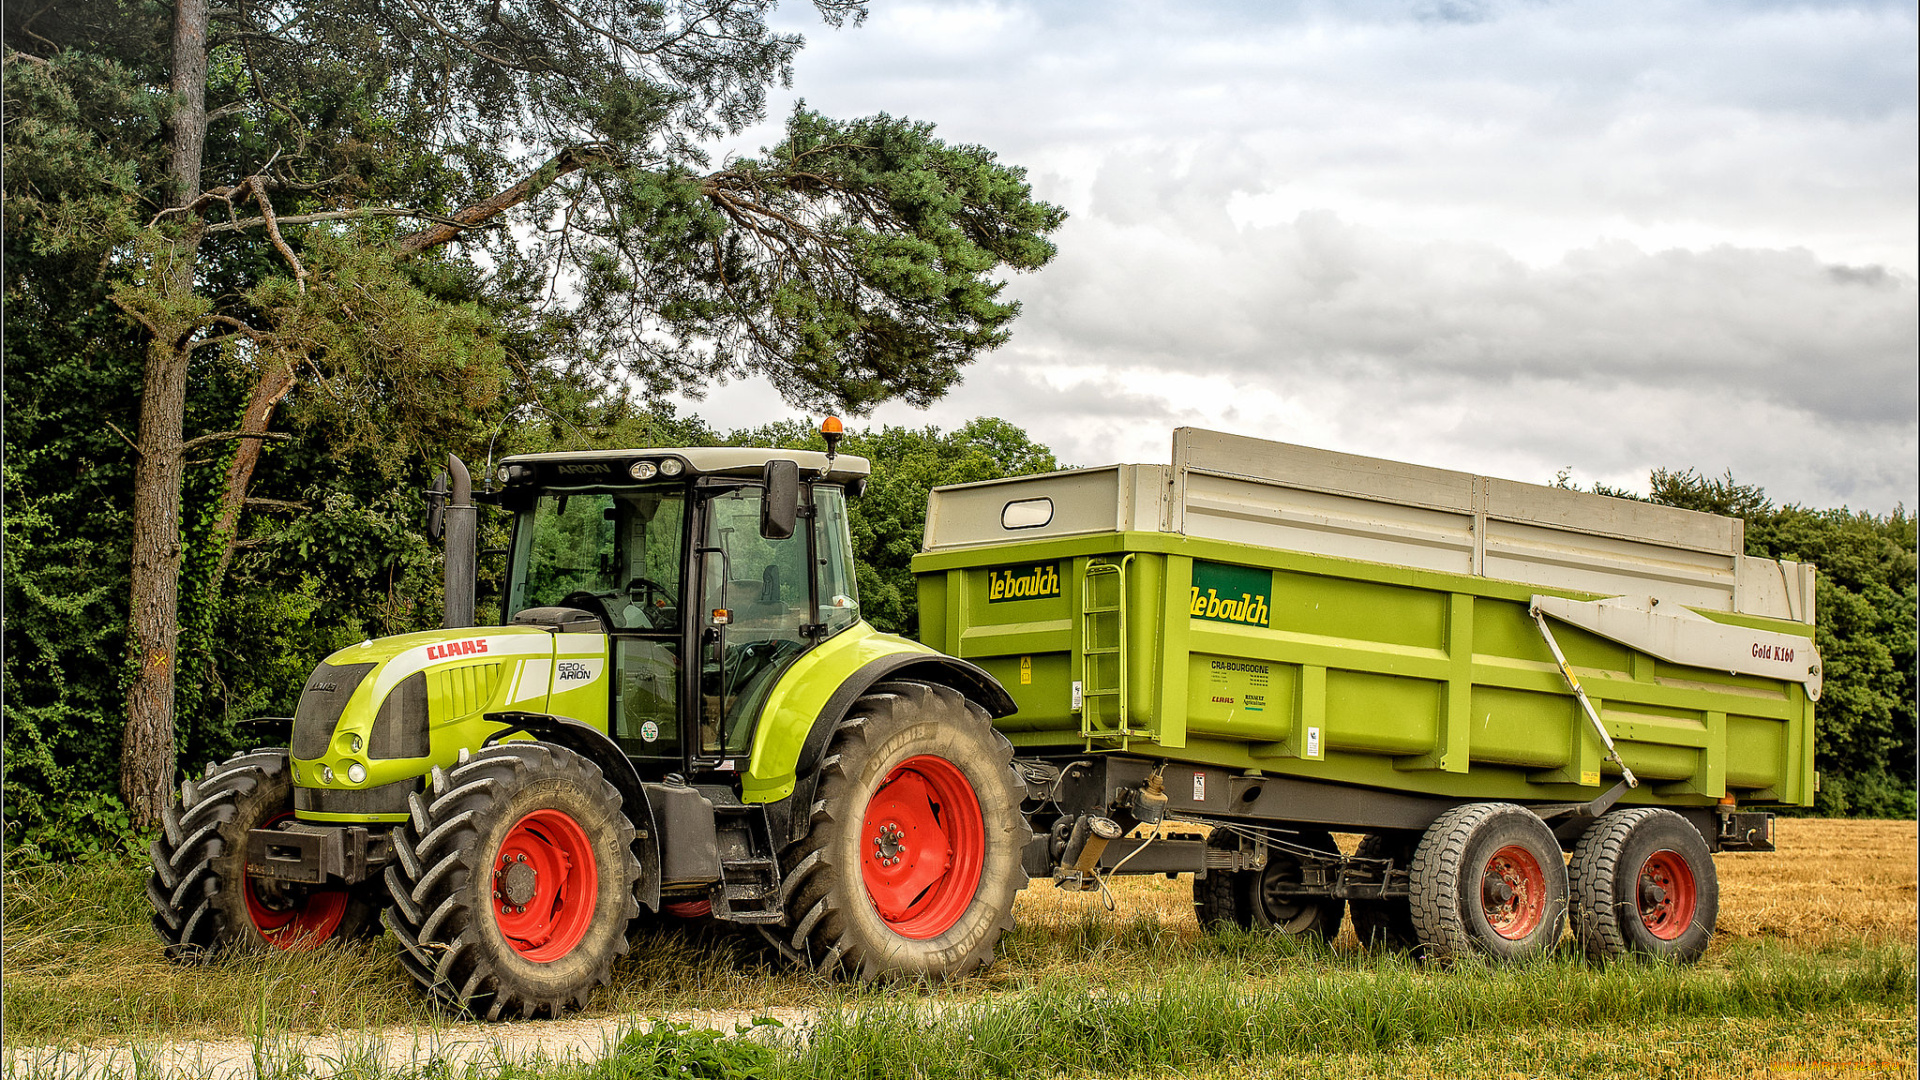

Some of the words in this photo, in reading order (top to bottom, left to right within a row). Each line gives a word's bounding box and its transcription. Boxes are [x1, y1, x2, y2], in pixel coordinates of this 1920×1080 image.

[558, 463, 611, 475] ARION
[426, 639, 488, 661] CLAAS
[1752, 642, 1772, 660] Gold
[1773, 645, 1795, 663] K160
[559, 670, 591, 681] ARION
